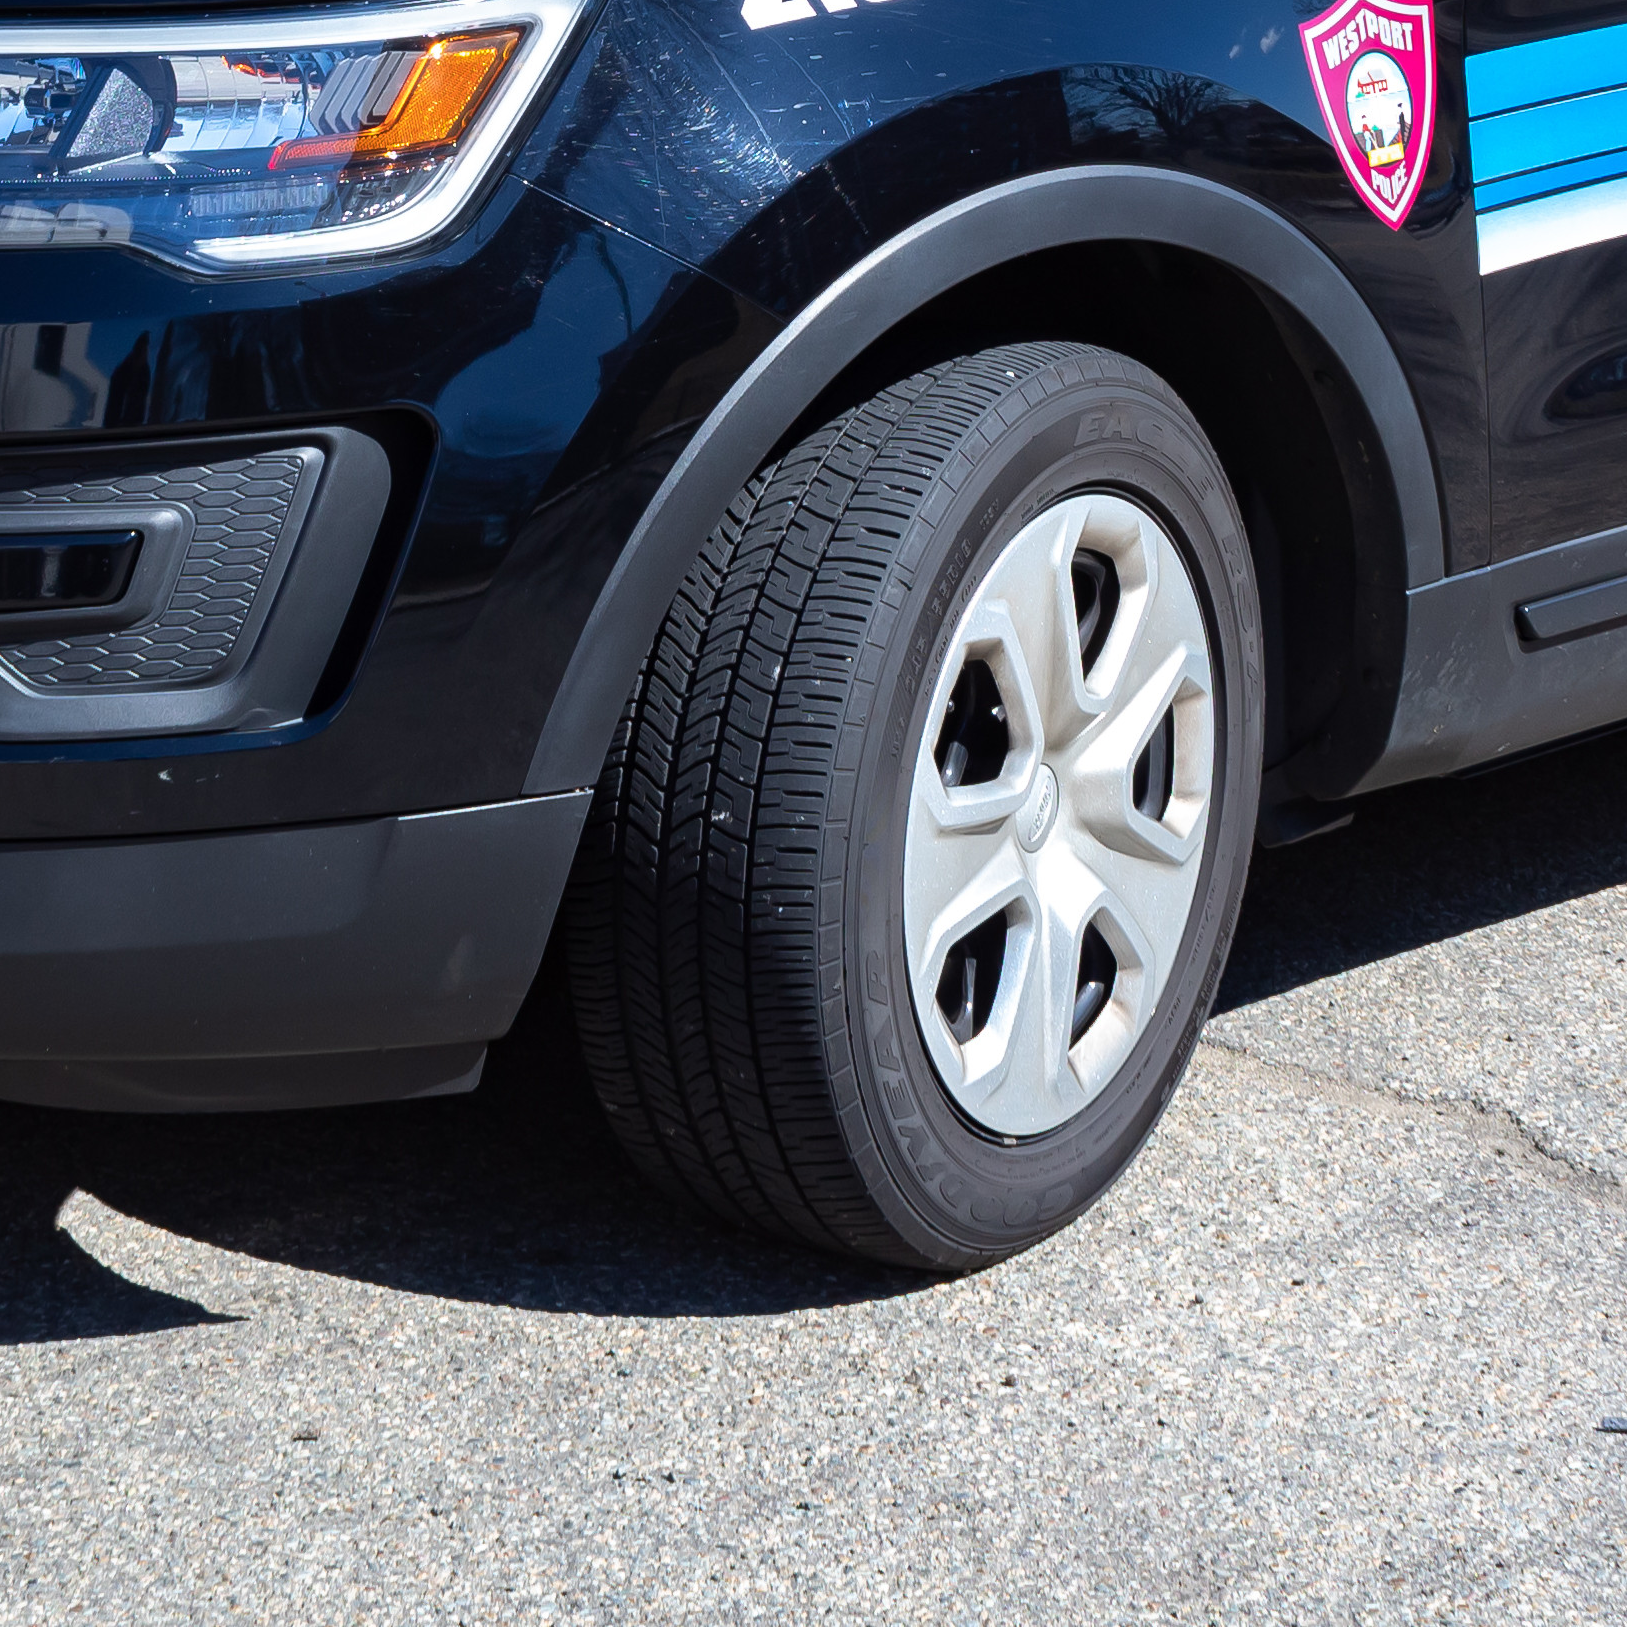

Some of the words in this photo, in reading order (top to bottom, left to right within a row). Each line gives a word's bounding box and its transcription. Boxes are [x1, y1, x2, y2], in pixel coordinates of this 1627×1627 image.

[1321, 8, 1414, 71] WESTPORT
[1370, 159, 1409, 206] POLICE
[864, 948, 1077, 1227] GOODYEAR
